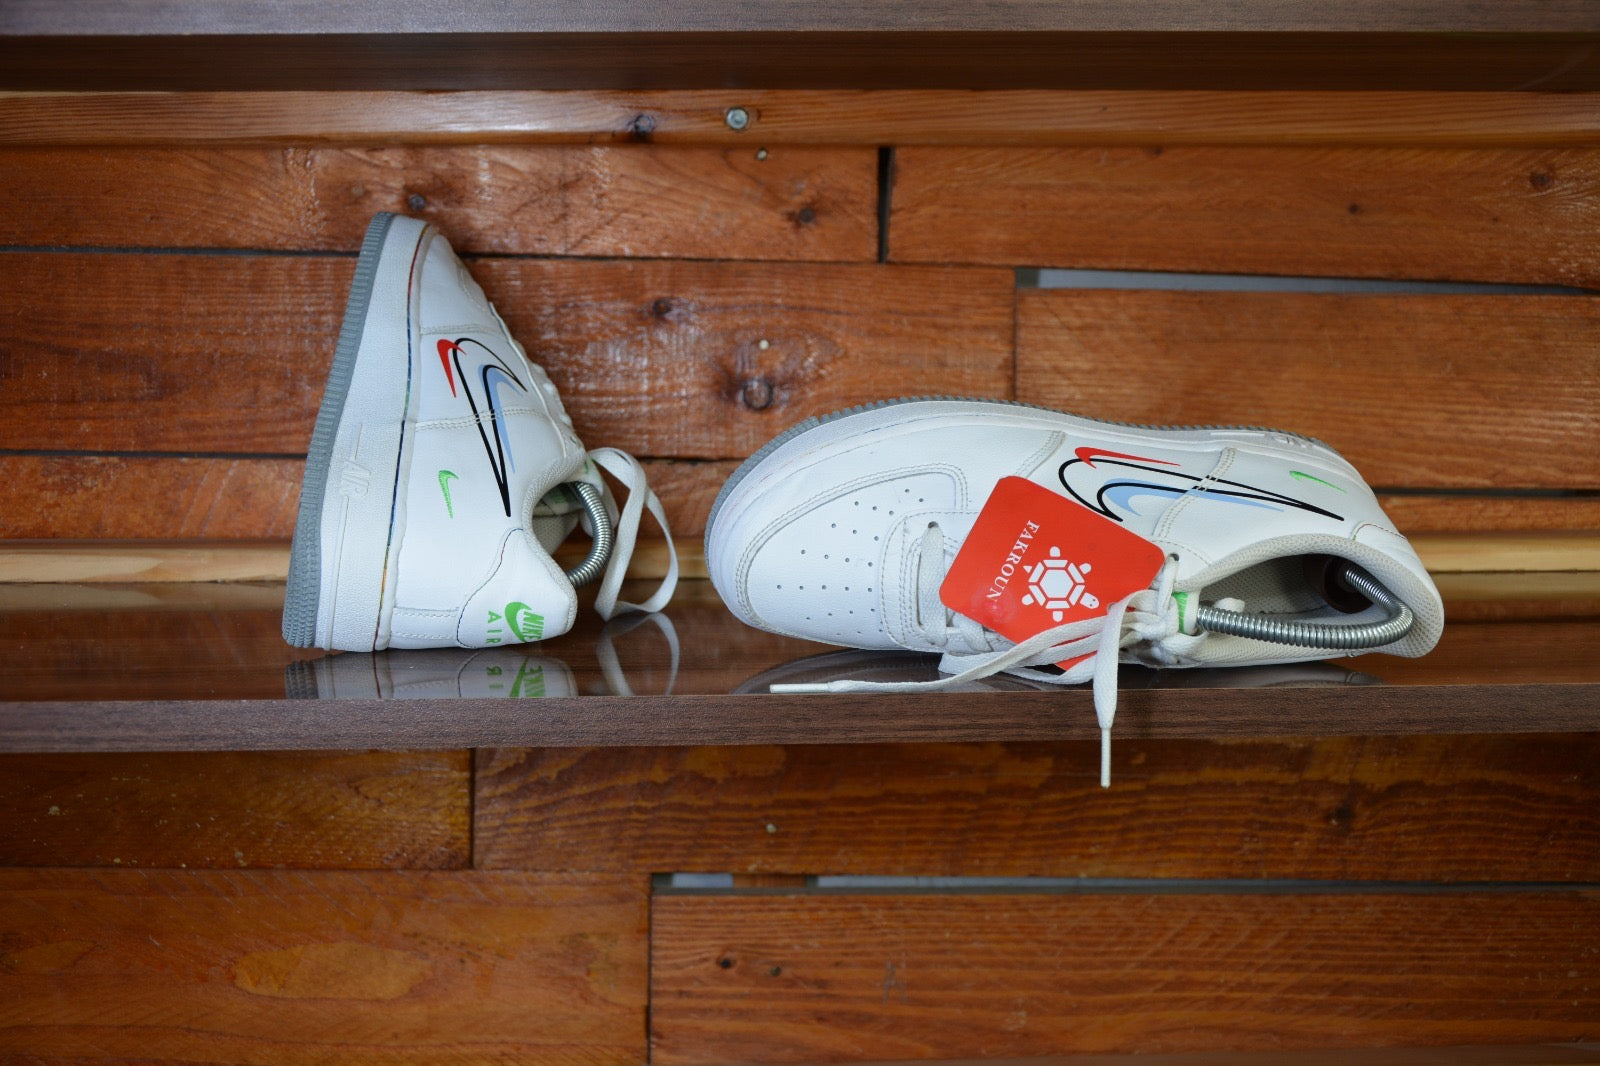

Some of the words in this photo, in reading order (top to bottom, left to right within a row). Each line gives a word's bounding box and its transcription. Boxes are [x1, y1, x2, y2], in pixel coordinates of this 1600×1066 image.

[986, 520, 1040, 601] FAKROUN
[485, 610, 503, 644] AIR
[522, 611, 545, 641] NIKE
